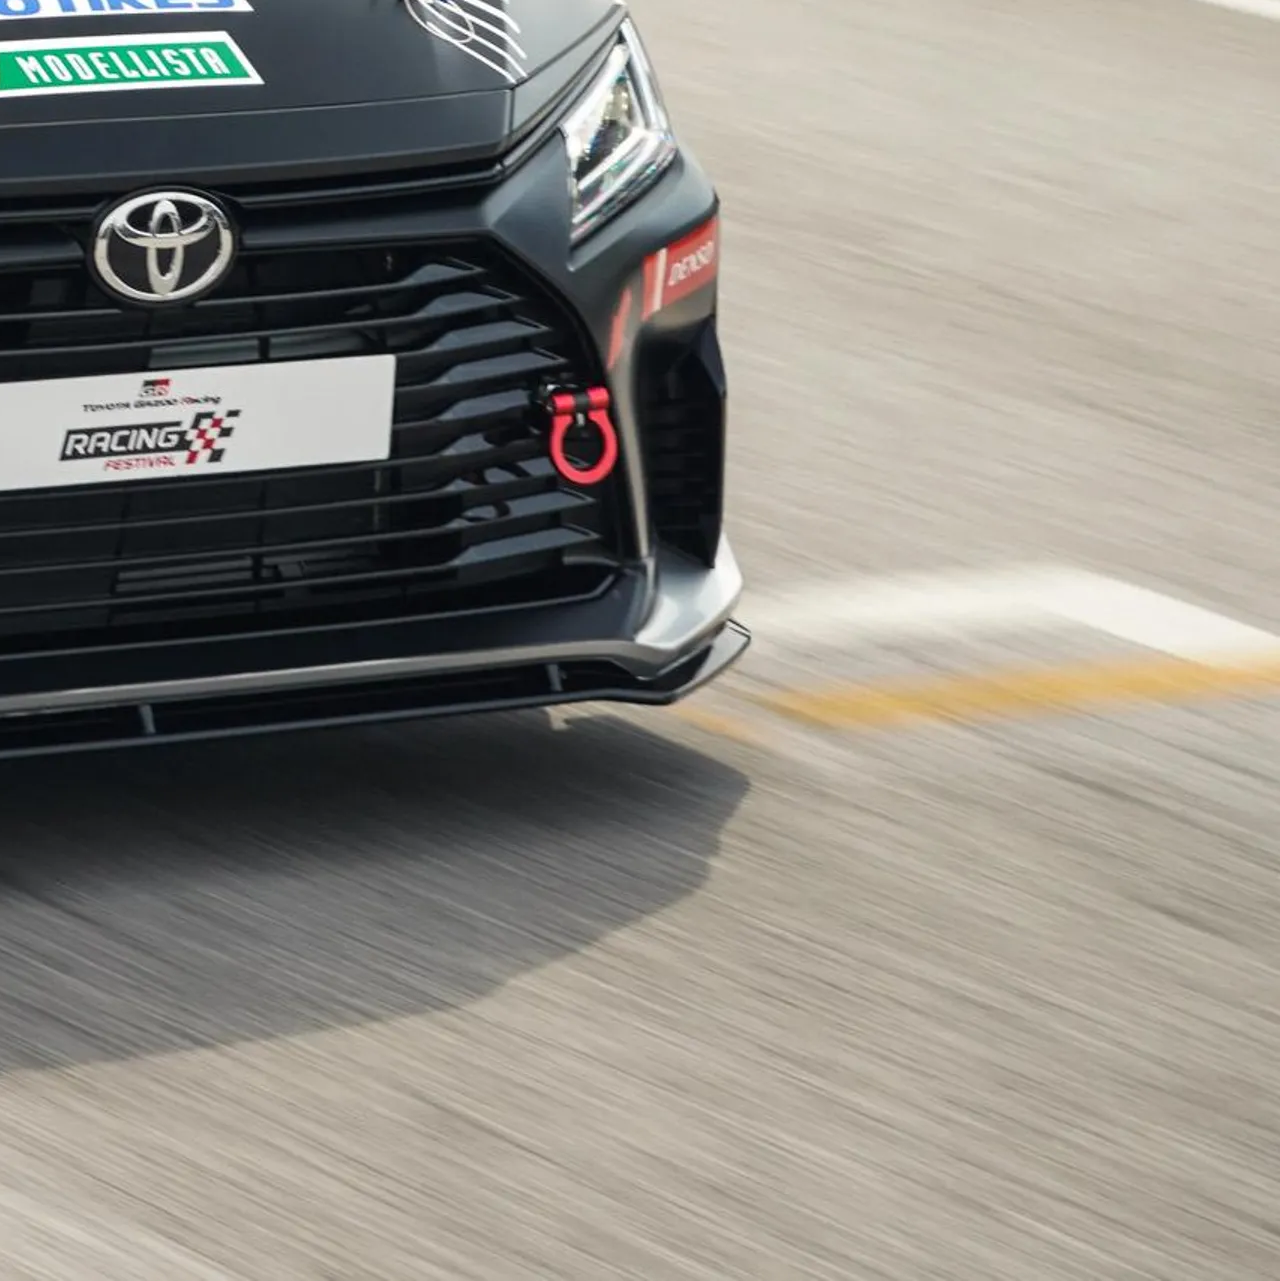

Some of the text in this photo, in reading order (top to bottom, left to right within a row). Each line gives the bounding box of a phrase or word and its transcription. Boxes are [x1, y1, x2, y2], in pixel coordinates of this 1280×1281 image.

[15, 45, 232, 85] MODELLISTA
[64, 426, 180, 456] RACING
[103, 455, 176, 470] FESTIVAL
